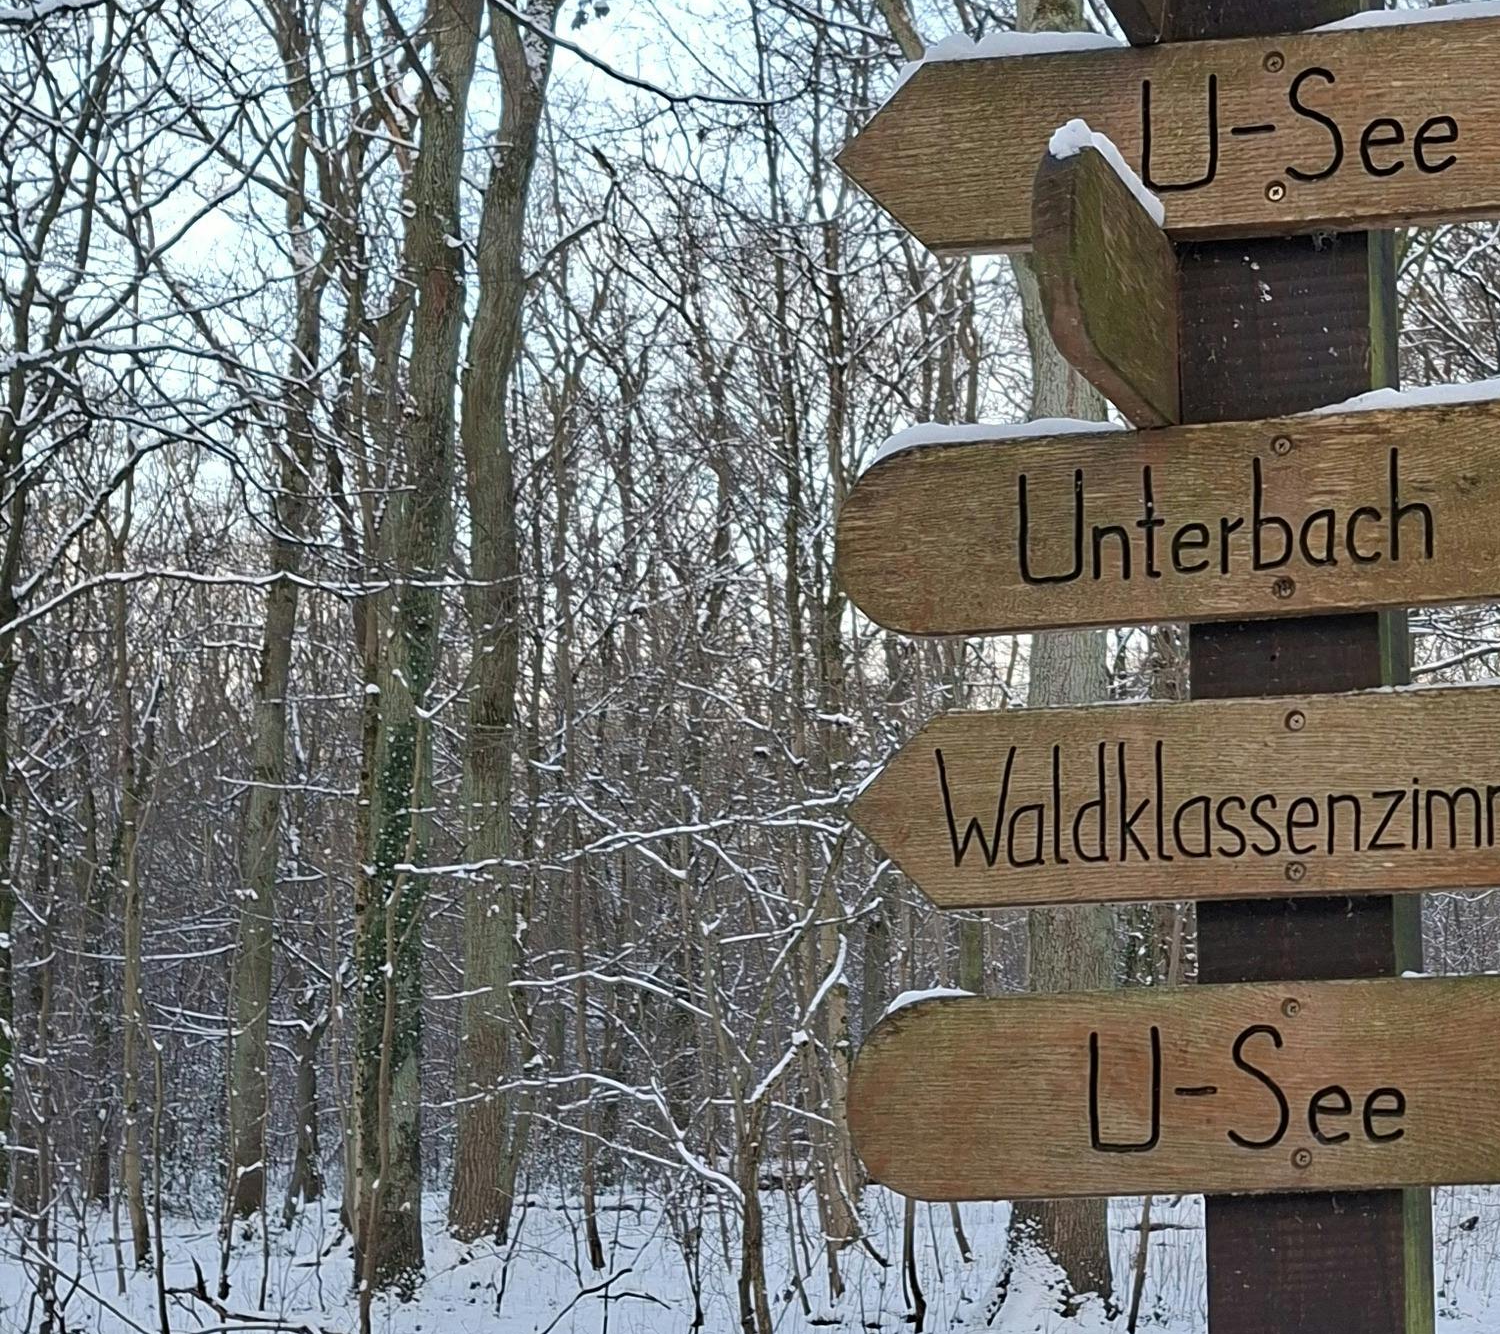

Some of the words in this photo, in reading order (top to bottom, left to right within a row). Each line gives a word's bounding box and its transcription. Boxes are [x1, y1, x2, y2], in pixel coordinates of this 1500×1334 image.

[1141, 67, 1460, 192] U-See
[1017, 447, 1435, 585] Unterbach
[1088, 1024, 1407, 1154] U-See
